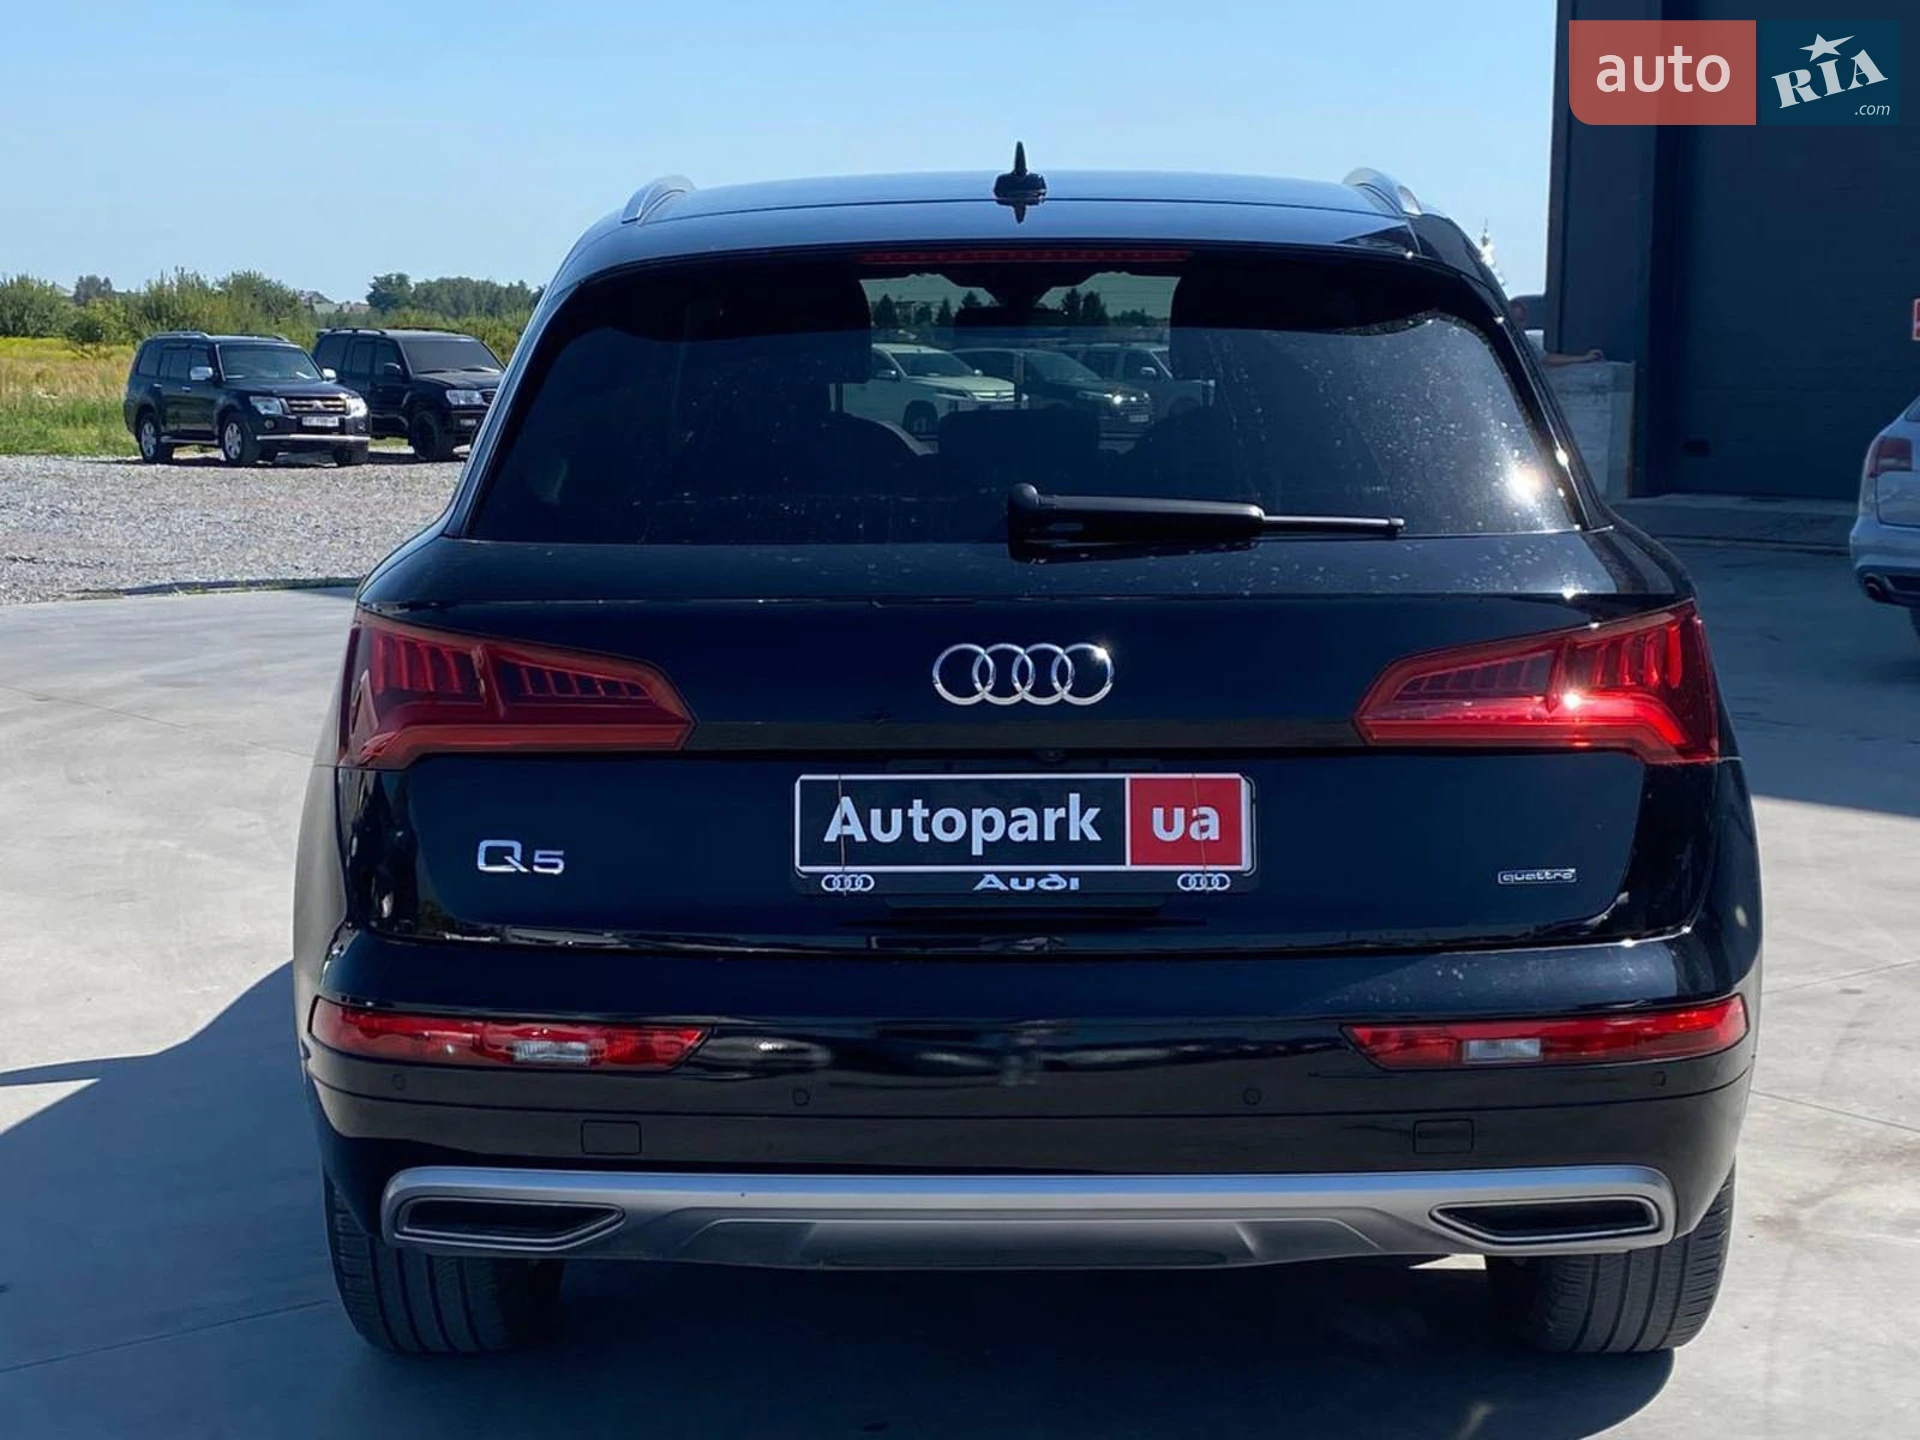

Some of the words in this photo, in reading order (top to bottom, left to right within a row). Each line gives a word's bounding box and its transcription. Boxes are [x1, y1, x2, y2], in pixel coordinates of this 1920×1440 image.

[823, 793, 1102, 856] Autopark
[1152, 805, 1220, 842] ua
[478, 839, 565, 875] Q5
[972, 873, 1080, 891] Audi
[1501, 869, 1574, 883] quattro
